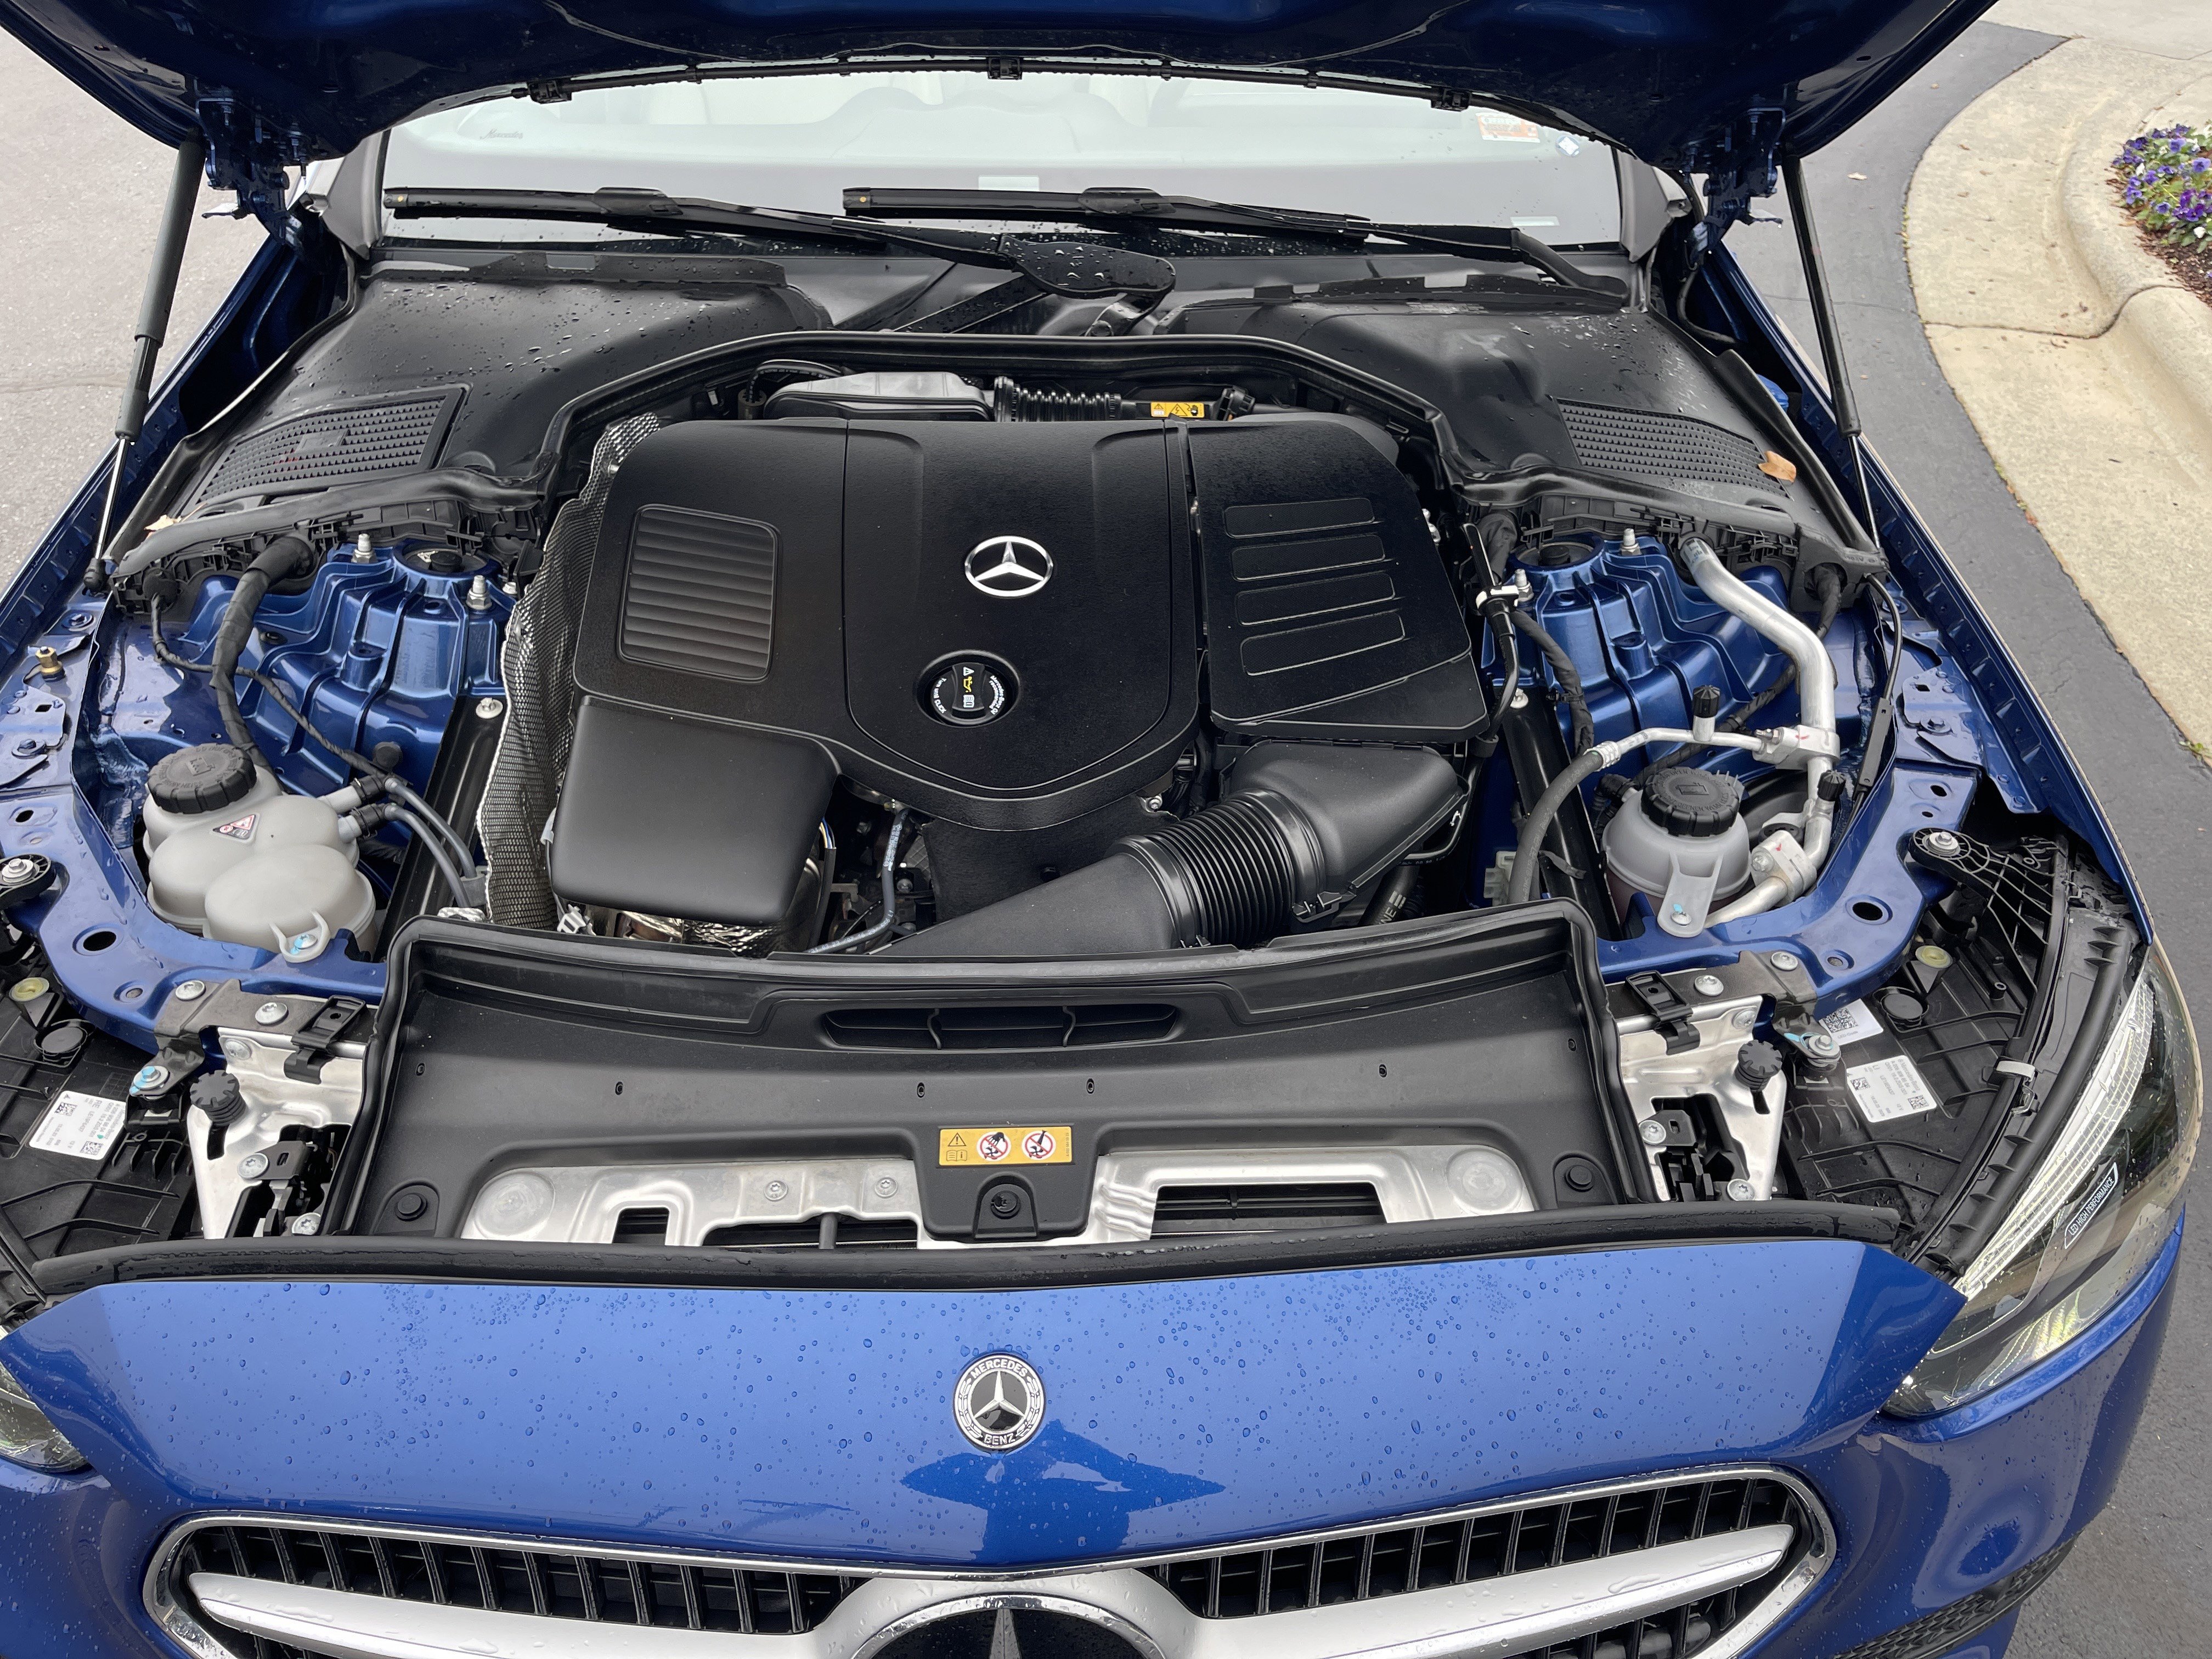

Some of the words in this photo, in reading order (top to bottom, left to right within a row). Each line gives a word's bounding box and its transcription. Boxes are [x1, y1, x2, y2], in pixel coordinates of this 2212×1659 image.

[935, 677, 947, 687] Turn
[934, 699, 947, 714] CLICK
[2068, 1224, 2079, 1236] LED
[2076, 1209, 2089, 1227] HIGH
[2086, 1176, 2115, 1215] PERFORMANCE
[970, 1358, 1029, 1380] MERCEDES
[984, 1432, 1017, 1446] BENZ
